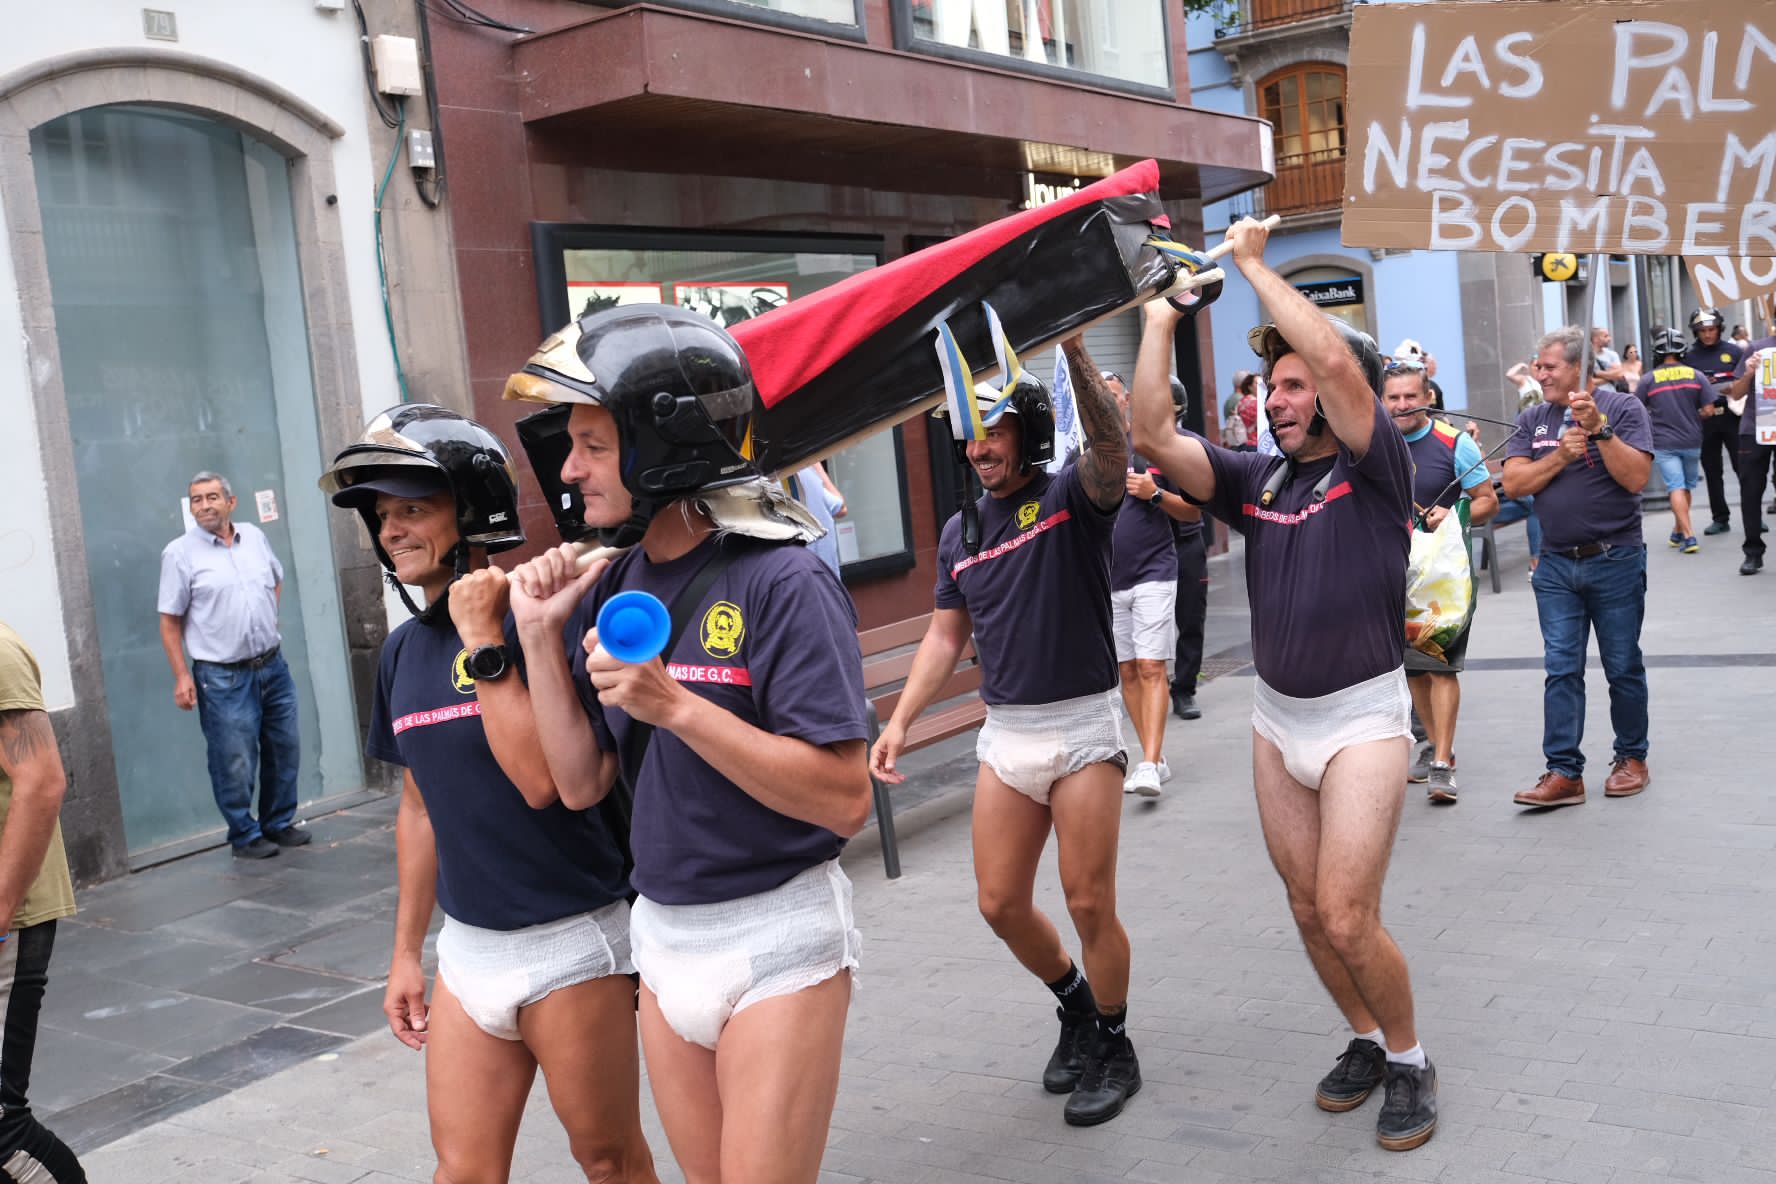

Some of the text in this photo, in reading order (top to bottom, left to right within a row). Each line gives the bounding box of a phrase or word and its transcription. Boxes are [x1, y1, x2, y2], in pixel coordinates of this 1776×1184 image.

[1406, 23, 1544, 111] LAS
[978, 551, 988, 561] DE
[989, 547, 1001, 559] LAS
[689, 666, 706, 681] DE
[404, 716, 413, 727] DE
[415, 713, 431, 724] LAS
[432, 707, 460, 721] PALMAS
[461, 704, 473, 716] DE
